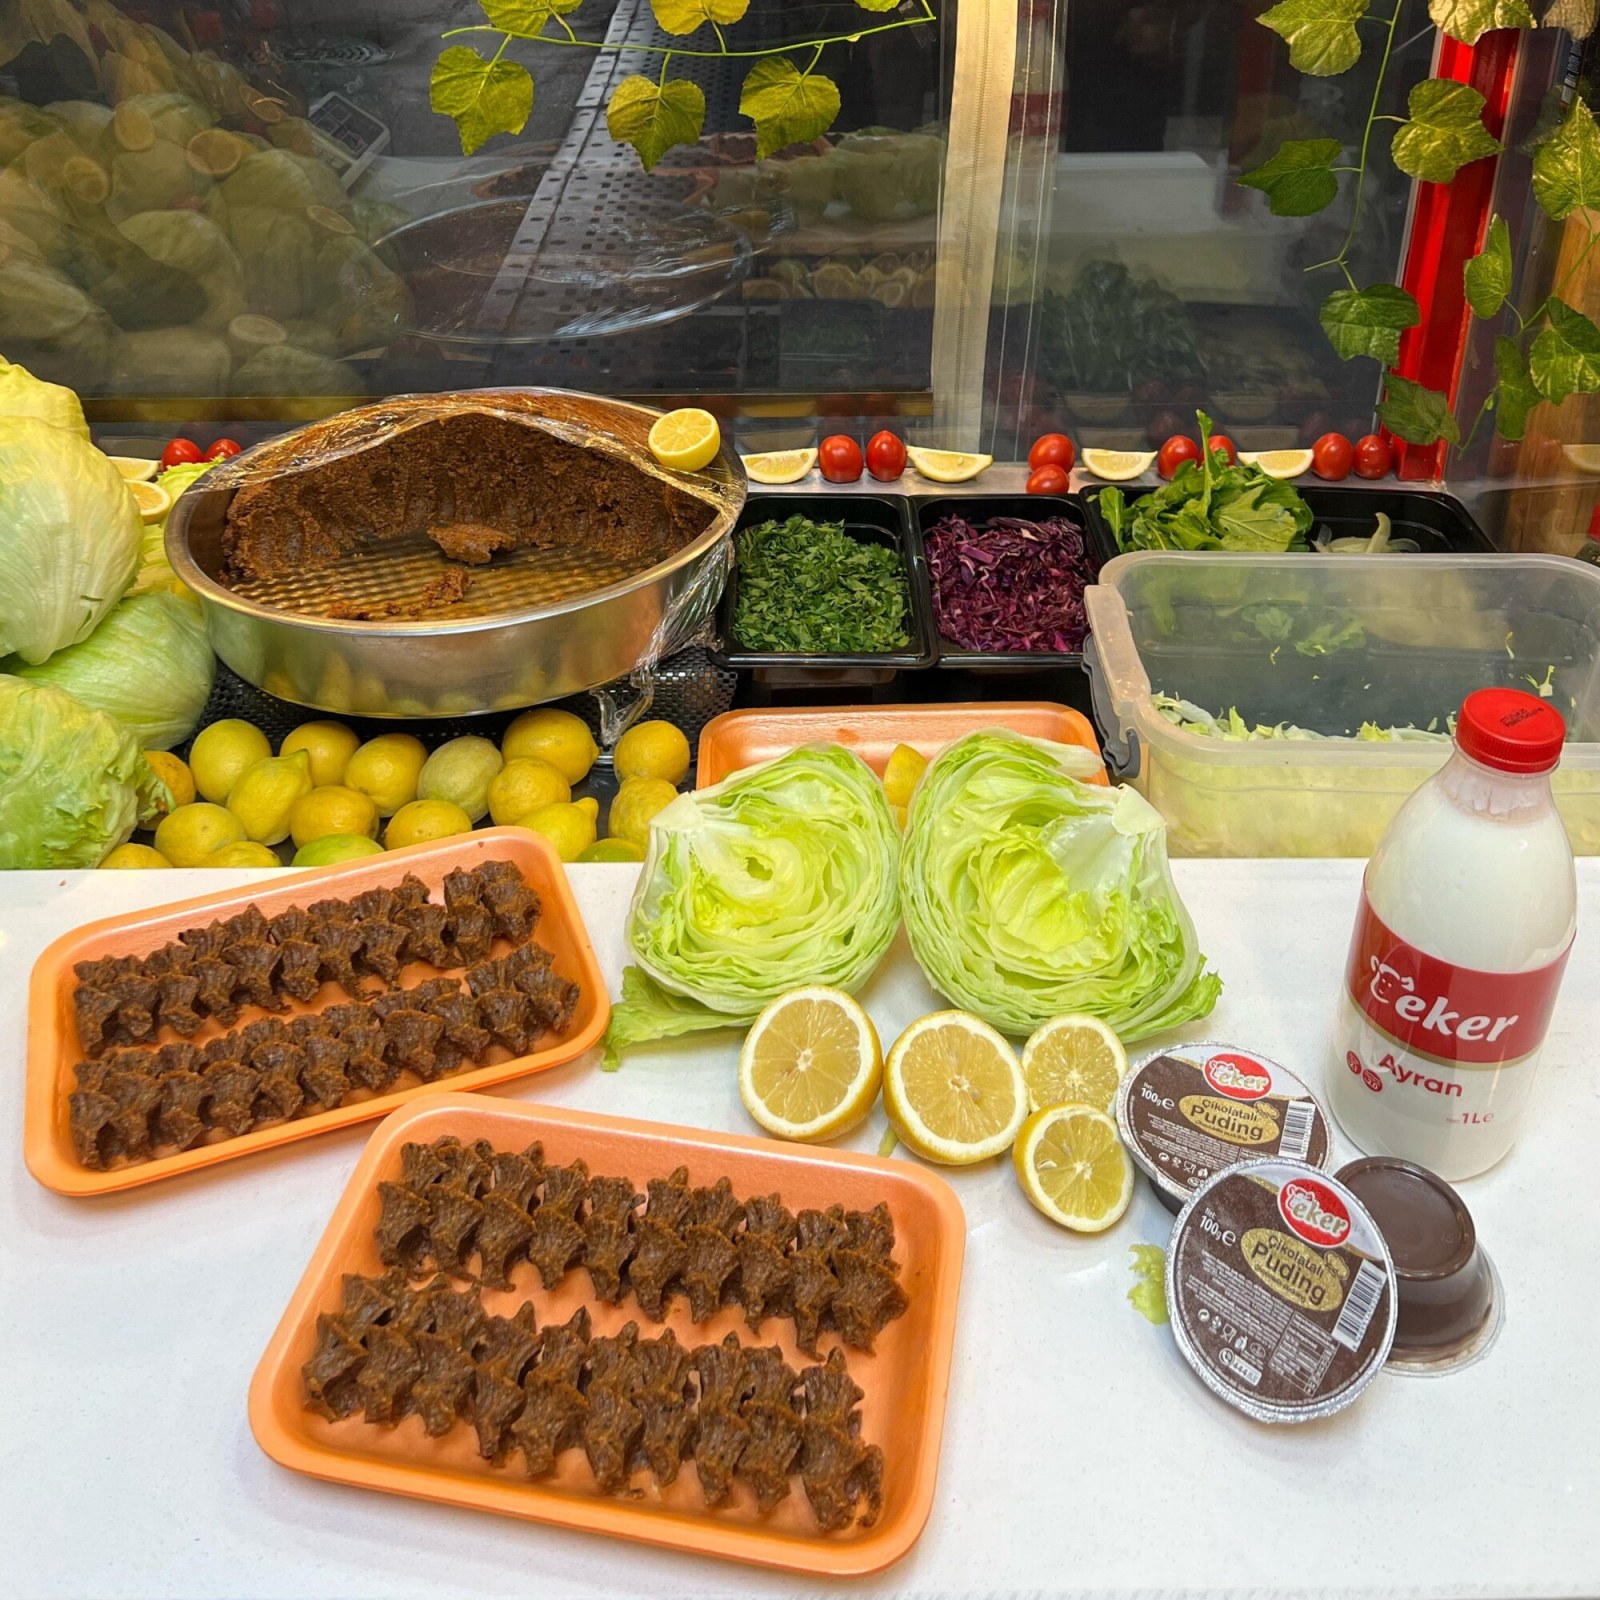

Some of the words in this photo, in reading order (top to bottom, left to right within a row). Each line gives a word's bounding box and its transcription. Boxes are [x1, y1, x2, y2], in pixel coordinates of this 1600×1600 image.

[1395, 995, 1519, 1041] eker
[1218, 1070, 1268, 1091] eker
[1379, 1053, 1463, 1097] Ayran
[1190, 1104, 1263, 1140] Puding
[1202, 1099, 1258, 1122] Çikolatalı
[1200, 1215, 1221, 1241] 100g
[1292, 1199, 1348, 1234] eker
[1251, 1241, 1327, 1306] Puding
[1268, 1235, 1324, 1278] Çikolatalı
